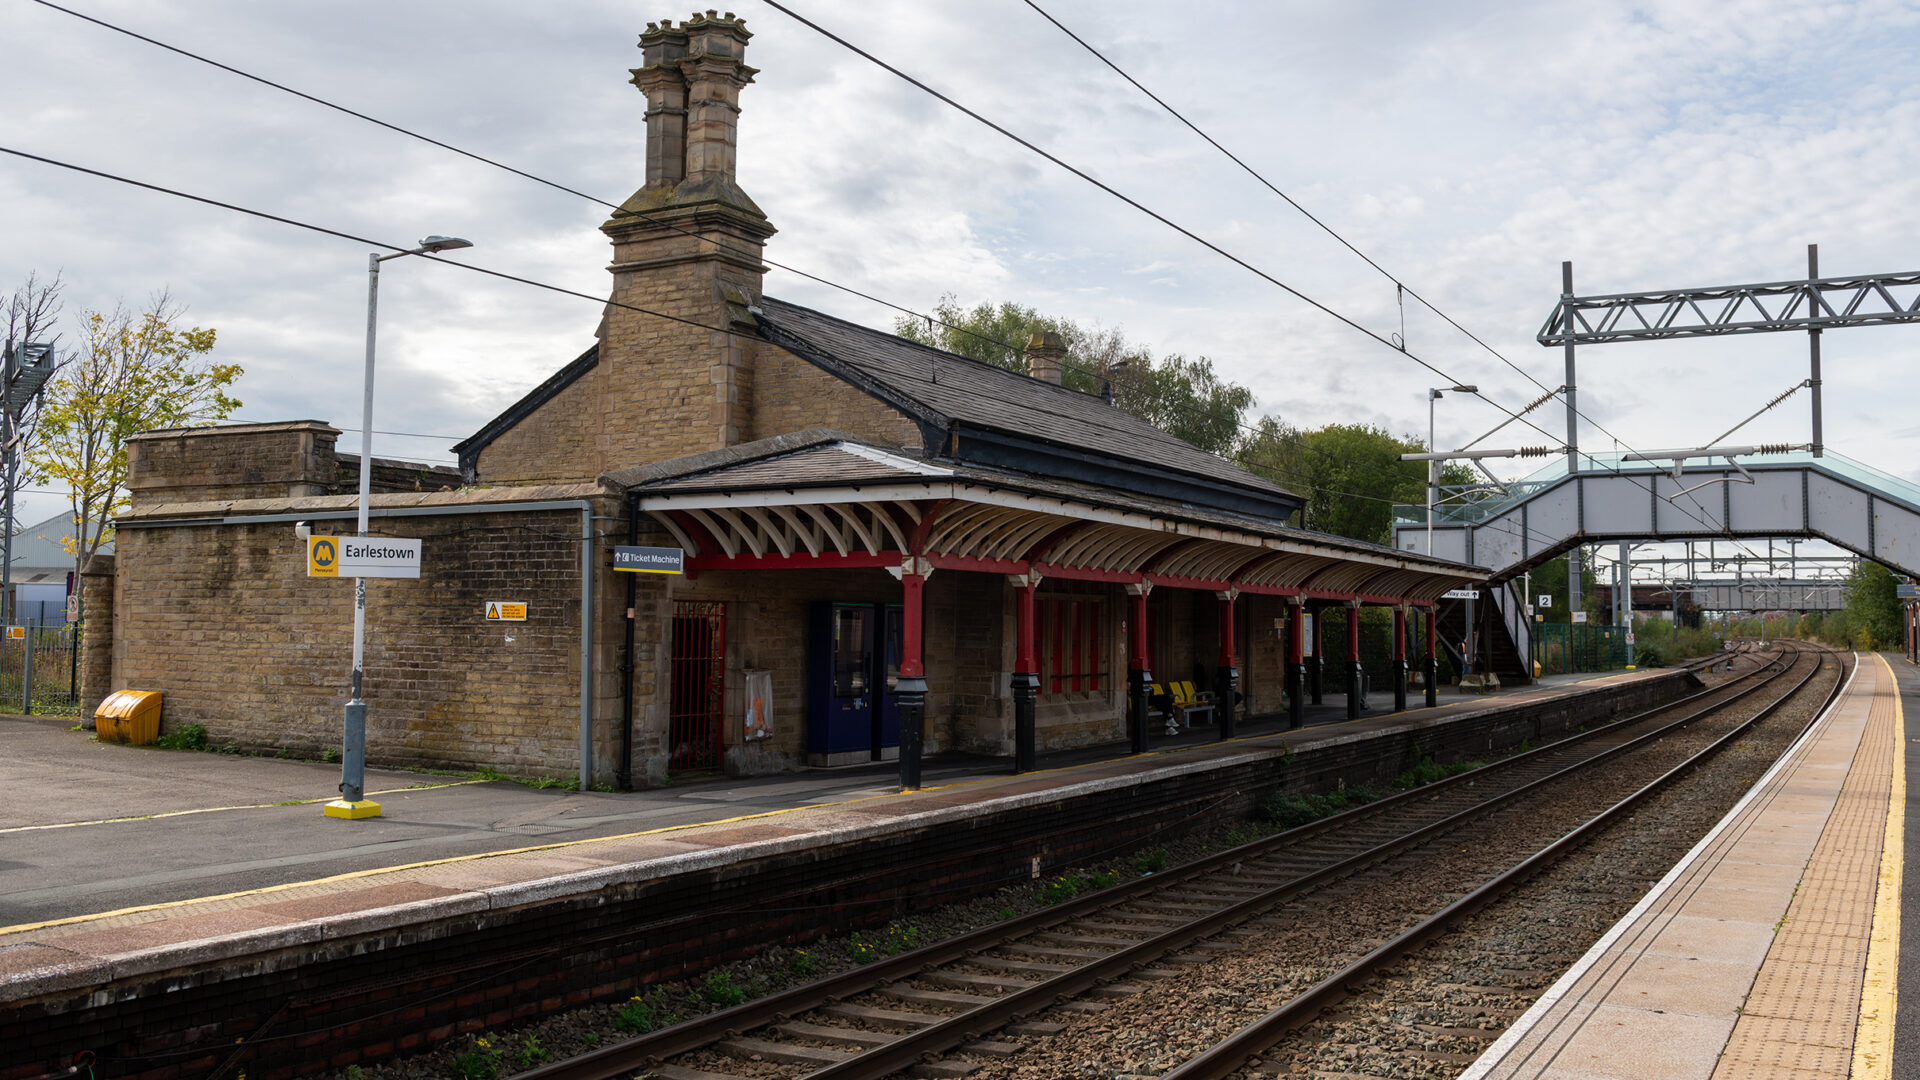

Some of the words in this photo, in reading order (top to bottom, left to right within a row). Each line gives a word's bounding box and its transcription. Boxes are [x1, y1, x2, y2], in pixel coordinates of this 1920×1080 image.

[346, 544, 414, 559] Earlestown
[630, 554, 650, 562] Ticket
[652, 555, 680, 564] Machine
[1542, 597, 1549, 606] 2
